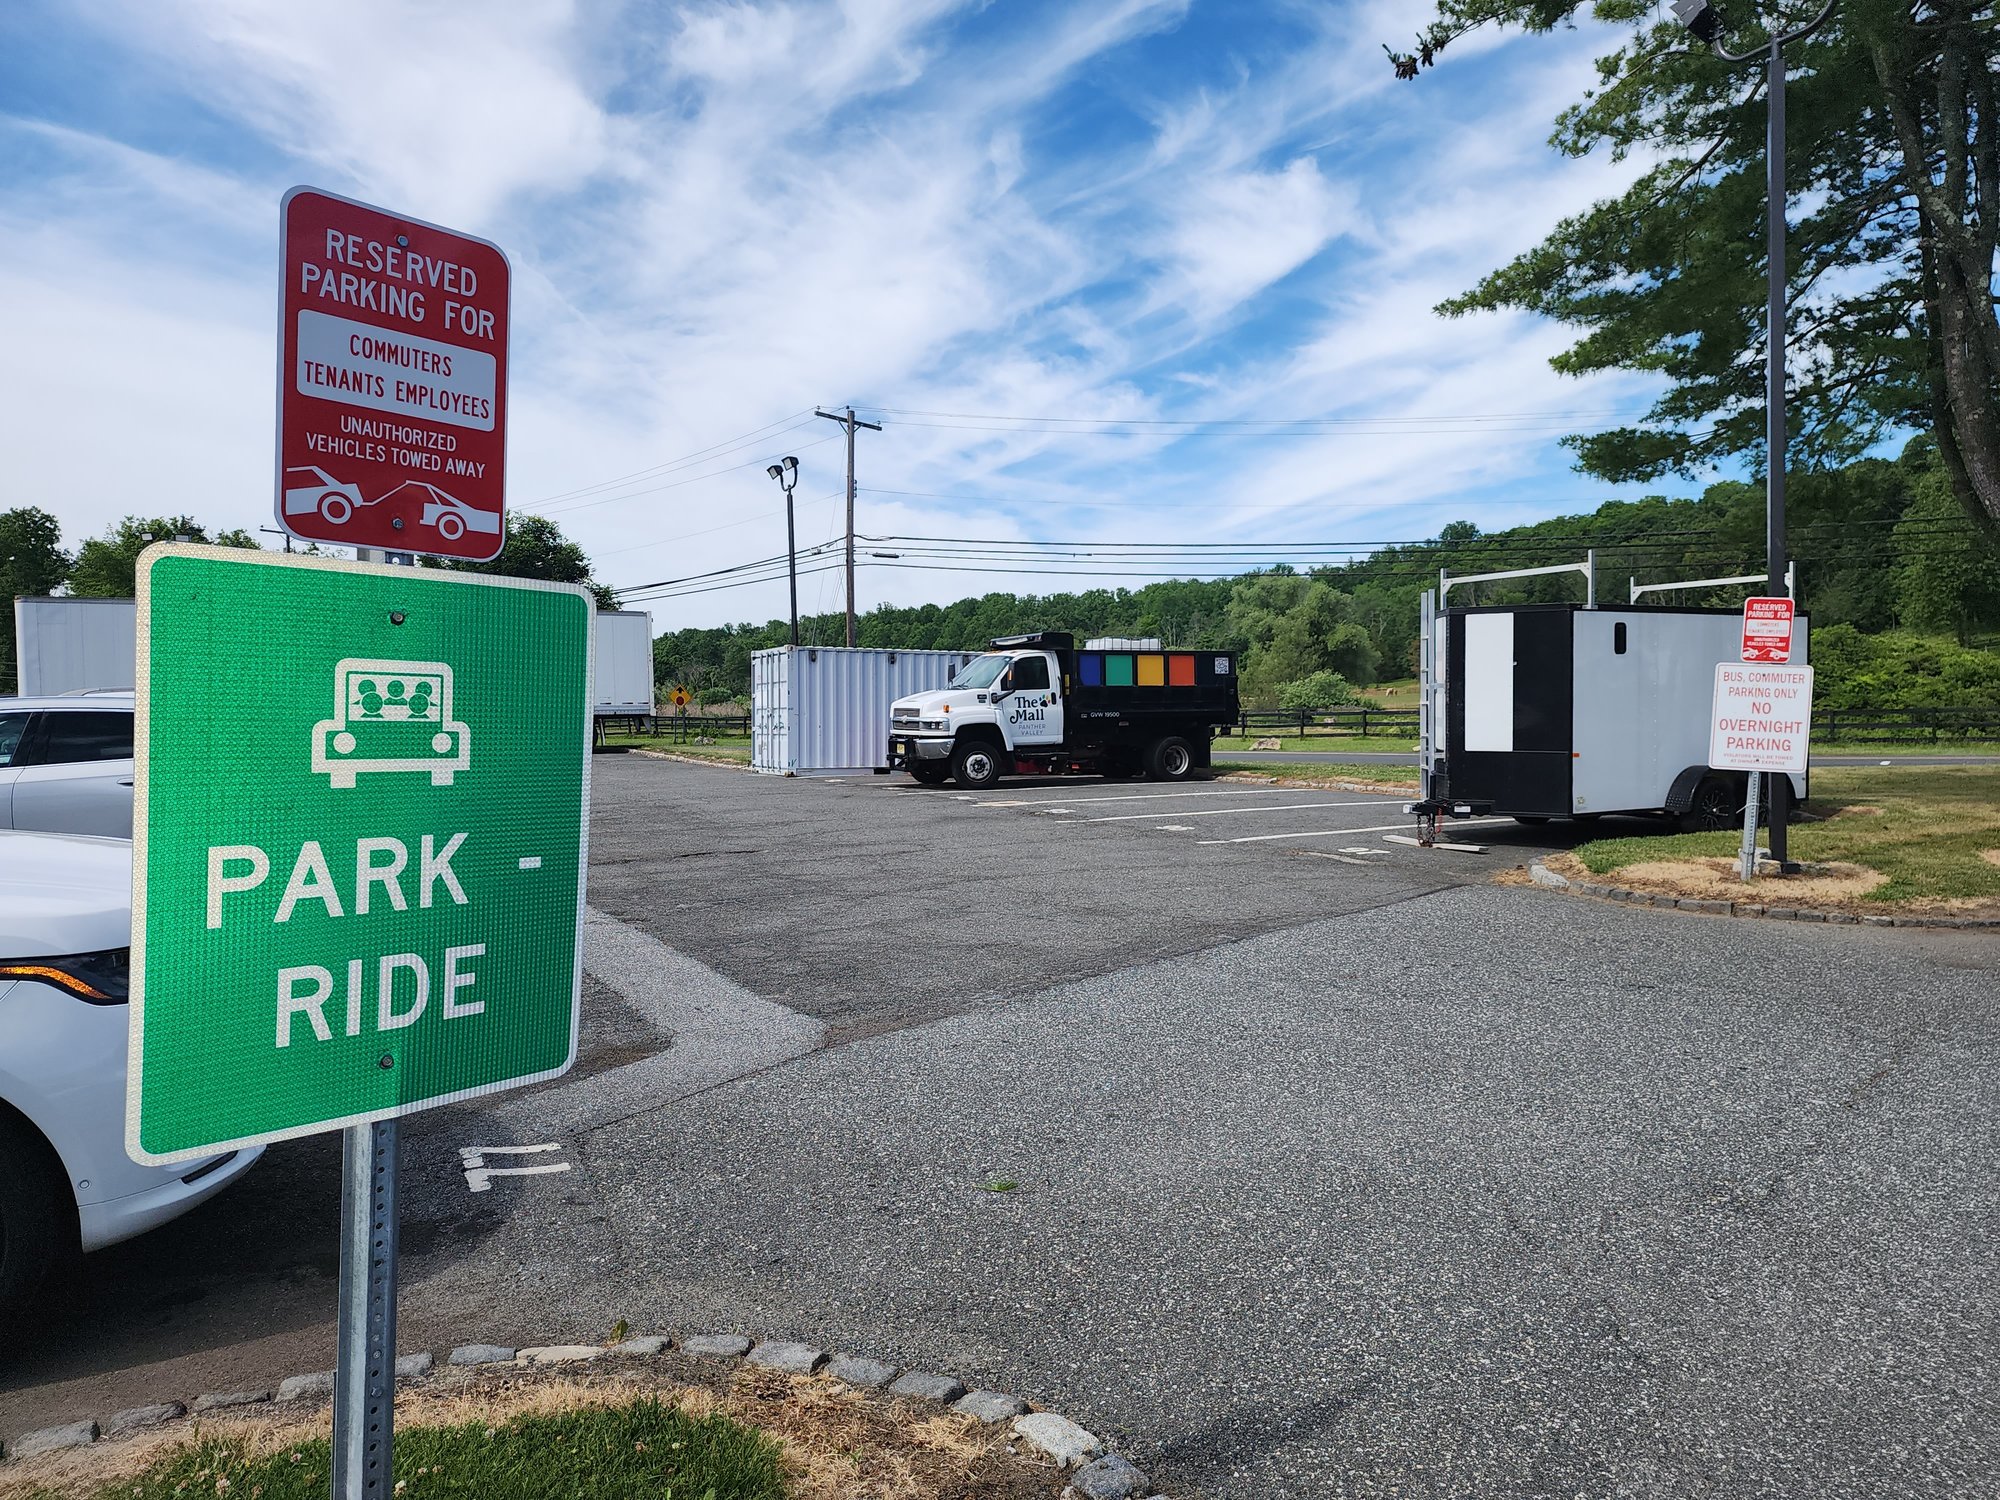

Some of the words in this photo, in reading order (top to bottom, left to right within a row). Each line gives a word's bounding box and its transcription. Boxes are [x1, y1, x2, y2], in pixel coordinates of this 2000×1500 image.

[326, 228, 477, 297] RESERVED
[301, 262, 425, 322] PARKING
[444, 301, 495, 340] FOR
[349, 334, 452, 377] COMMUTERS
[304, 360, 385, 398] TENANTS
[395, 381, 490, 420] EMPLOYEES
[340, 415, 456, 452] UNAUTHORIZED
[306, 432, 386, 463] VEHICLES
[391, 448, 441, 472] TOWED
[445, 457, 485, 479] AWAY
[1728, 687, 1771, 698] PARKING
[1774, 688, 1798, 699] ONLY
[1748, 672, 1805, 684] COMMUTER
[1010, 709, 1044, 724] Mall
[1014, 696, 1038, 708] The
[1751, 702, 1771, 715] NO
[1719, 718, 1803, 734] OVERNIGHT
[1726, 736, 1791, 752] PARKING
[206, 832, 470, 930] PARK
[276, 944, 486, 1049] RIDE
